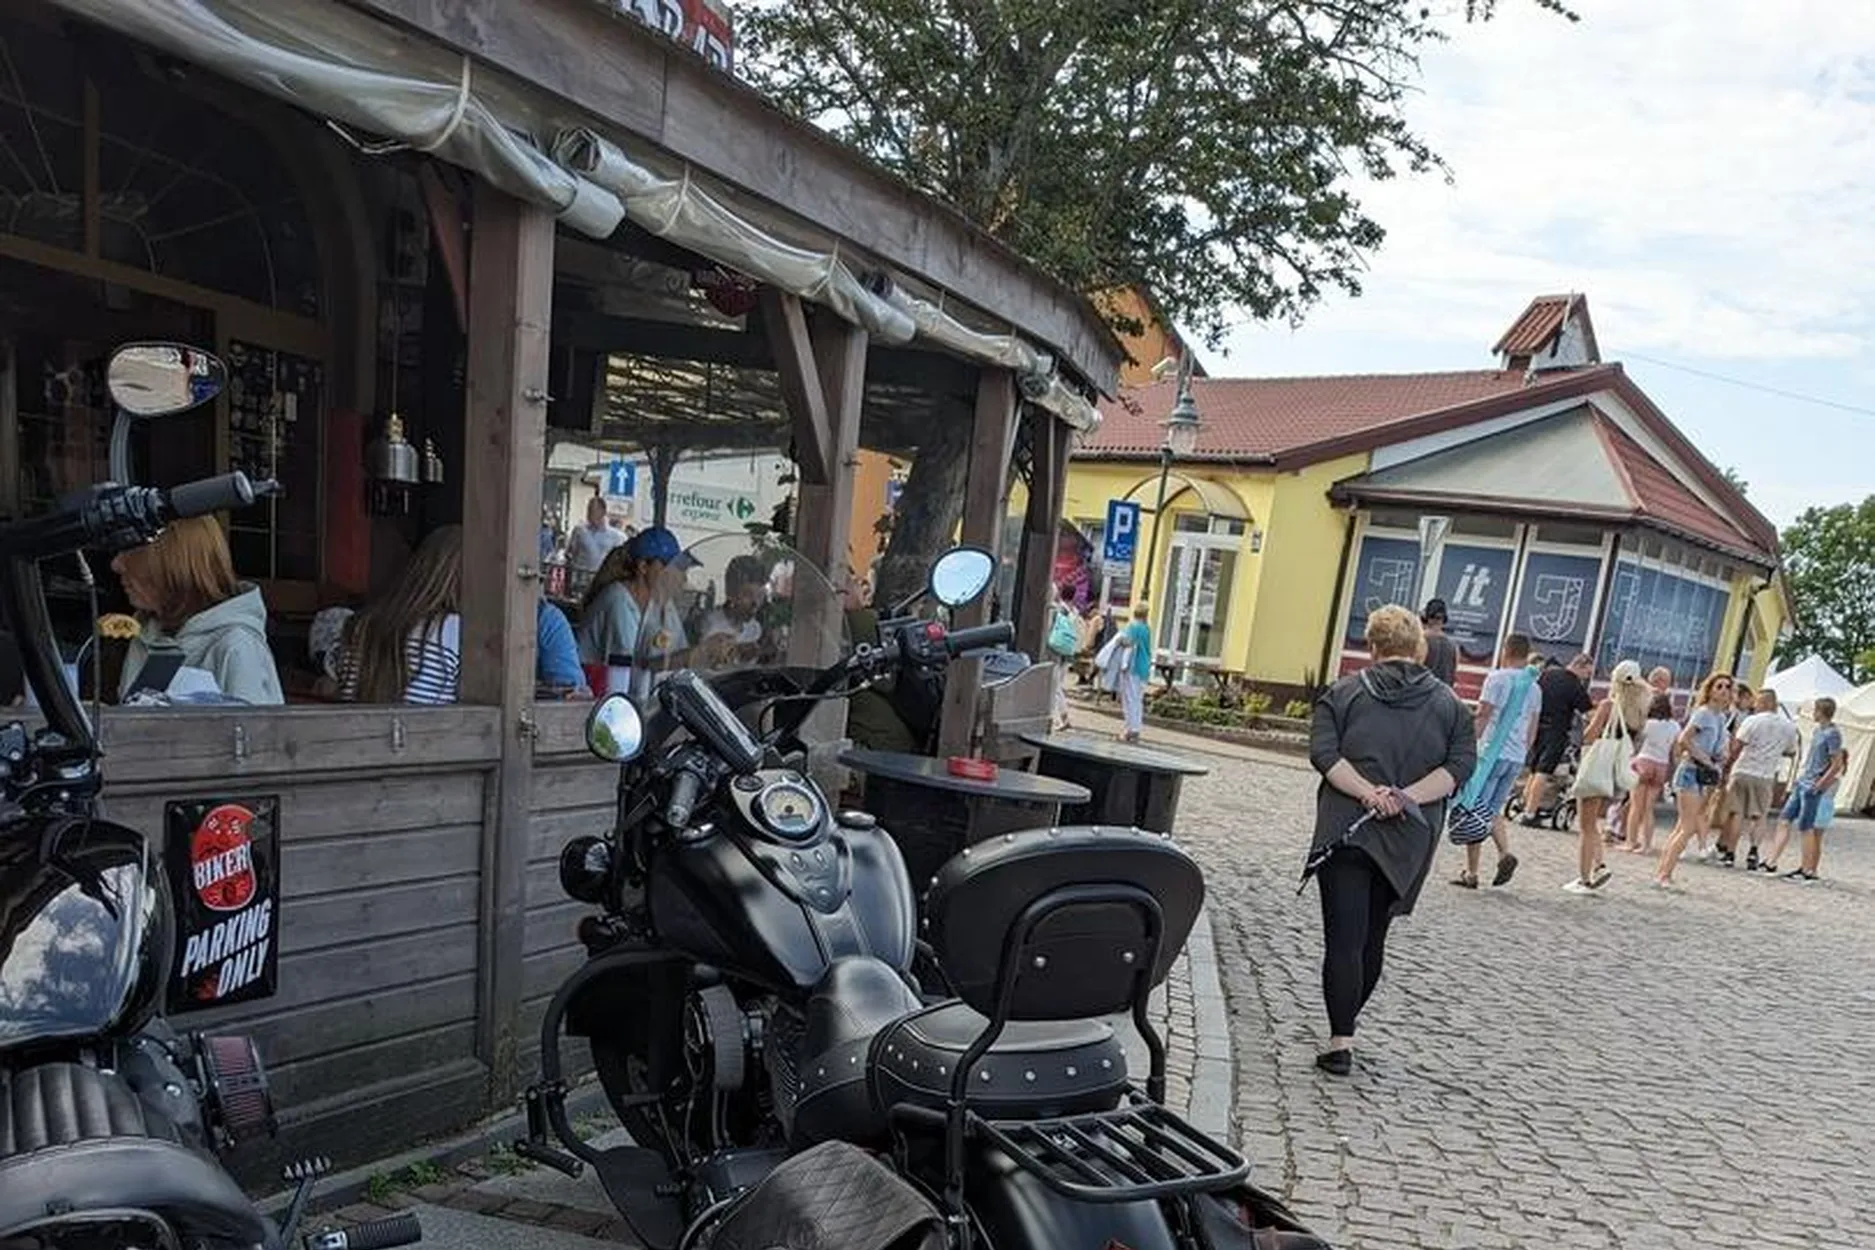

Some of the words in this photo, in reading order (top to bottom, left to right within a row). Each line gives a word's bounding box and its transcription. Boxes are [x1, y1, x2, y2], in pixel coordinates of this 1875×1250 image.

[670, 491, 722, 511] rrefour
[1112, 505, 1134, 543] P
[1453, 563, 1492, 607] it
[180, 897, 273, 978] PARKING
[216, 938, 270, 999] ONLY
